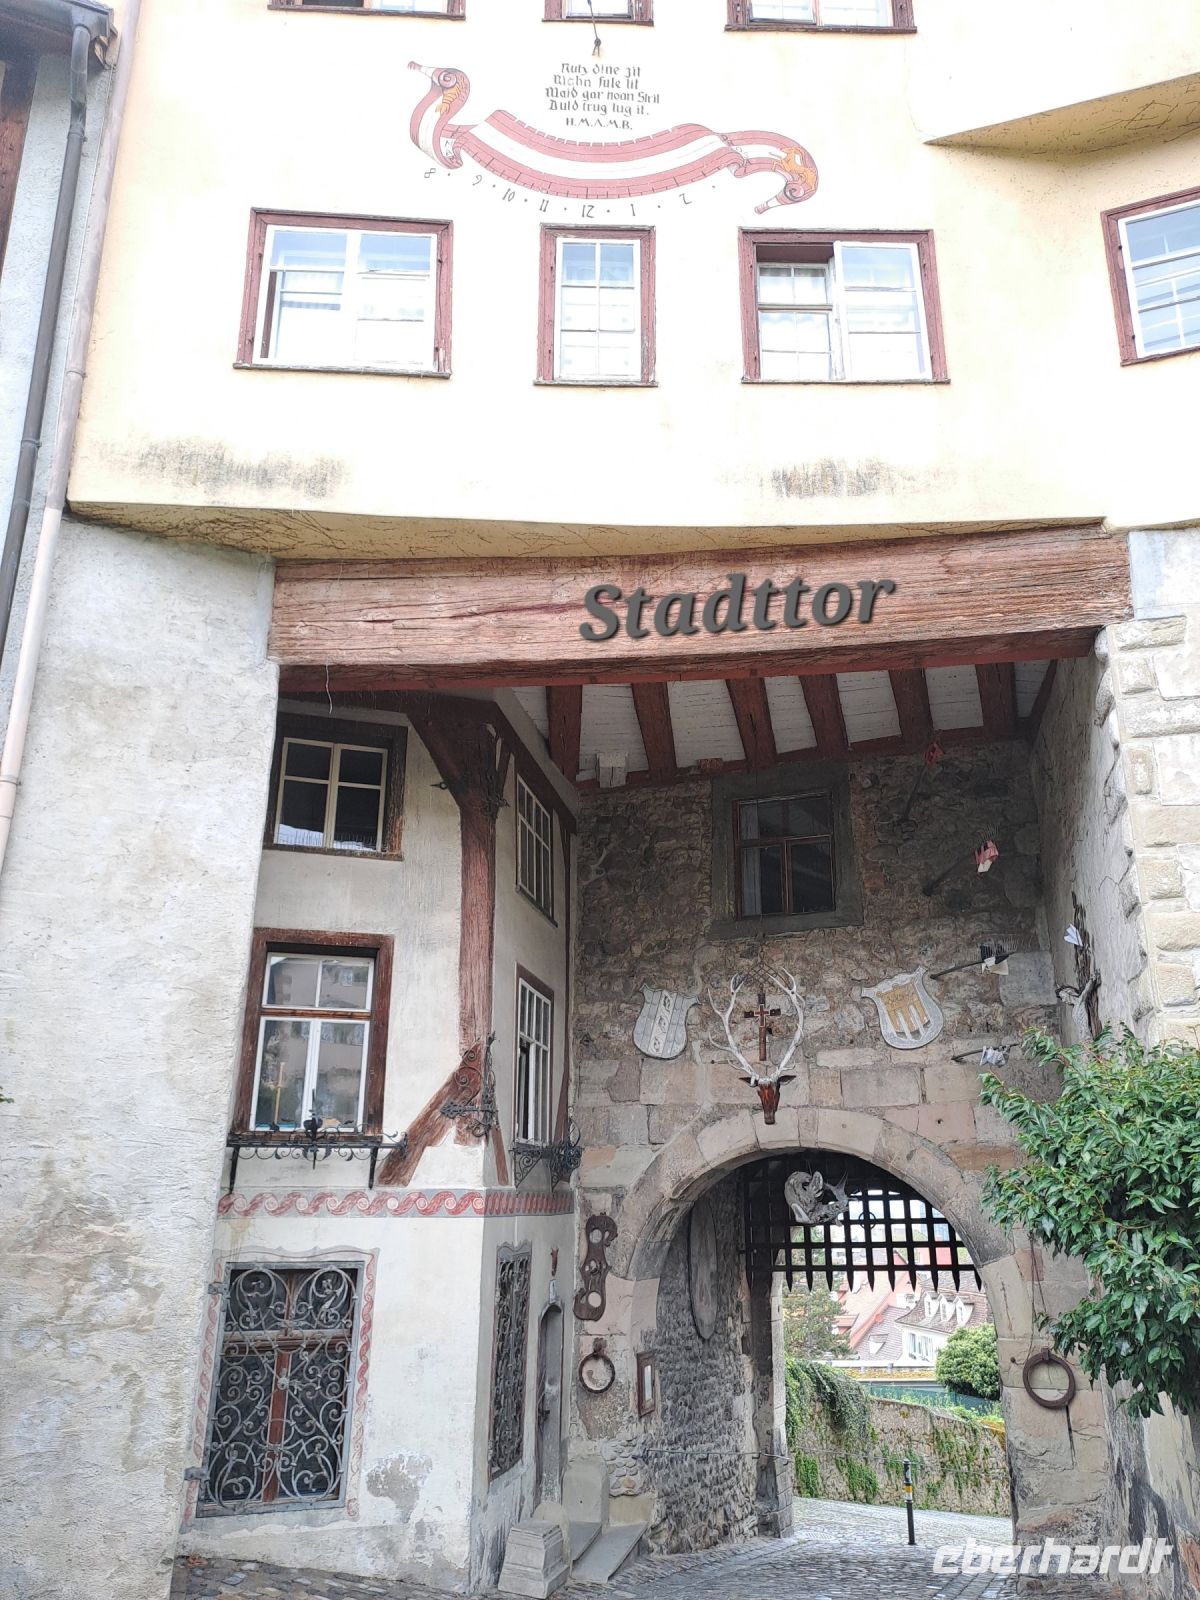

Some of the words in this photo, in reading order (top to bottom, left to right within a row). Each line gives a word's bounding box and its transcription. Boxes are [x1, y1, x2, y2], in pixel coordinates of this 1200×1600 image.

[472, 174, 483, 186] 9
[502, 188, 516, 202] 10
[539, 198, 549, 213] 11
[581, 204, 595, 219] 12
[630, 203, 636, 217] 1
[678, 192, 692, 205] 2
